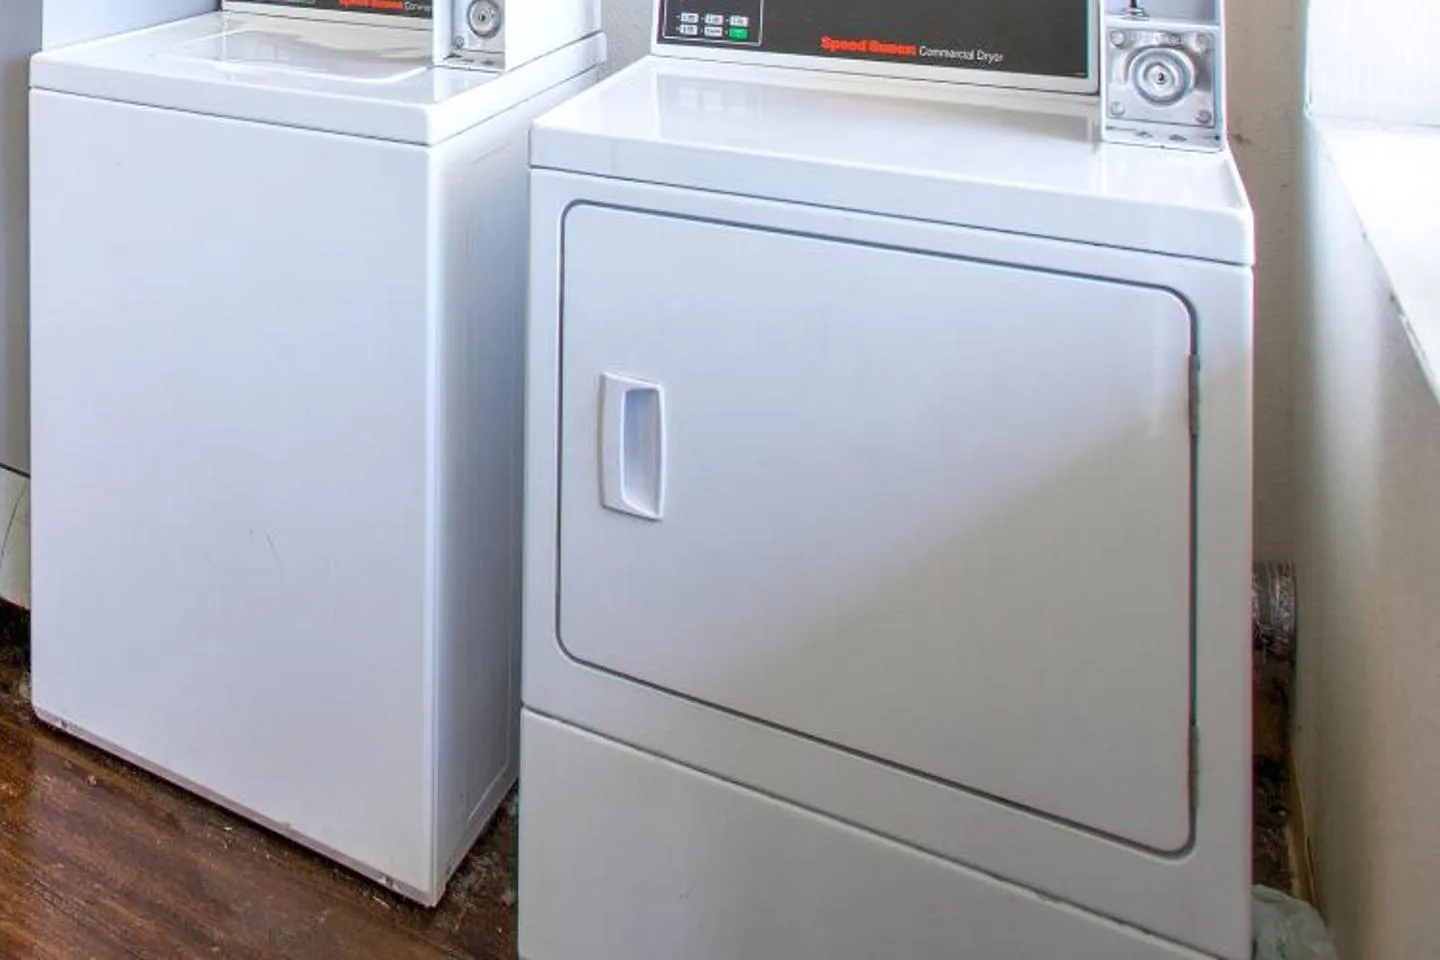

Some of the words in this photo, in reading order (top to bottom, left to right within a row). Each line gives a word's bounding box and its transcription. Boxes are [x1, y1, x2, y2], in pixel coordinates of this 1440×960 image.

[820, 36, 866, 53] Speed
[918, 45, 975, 60] Commercial
[976, 49, 1004, 64] Dryer
